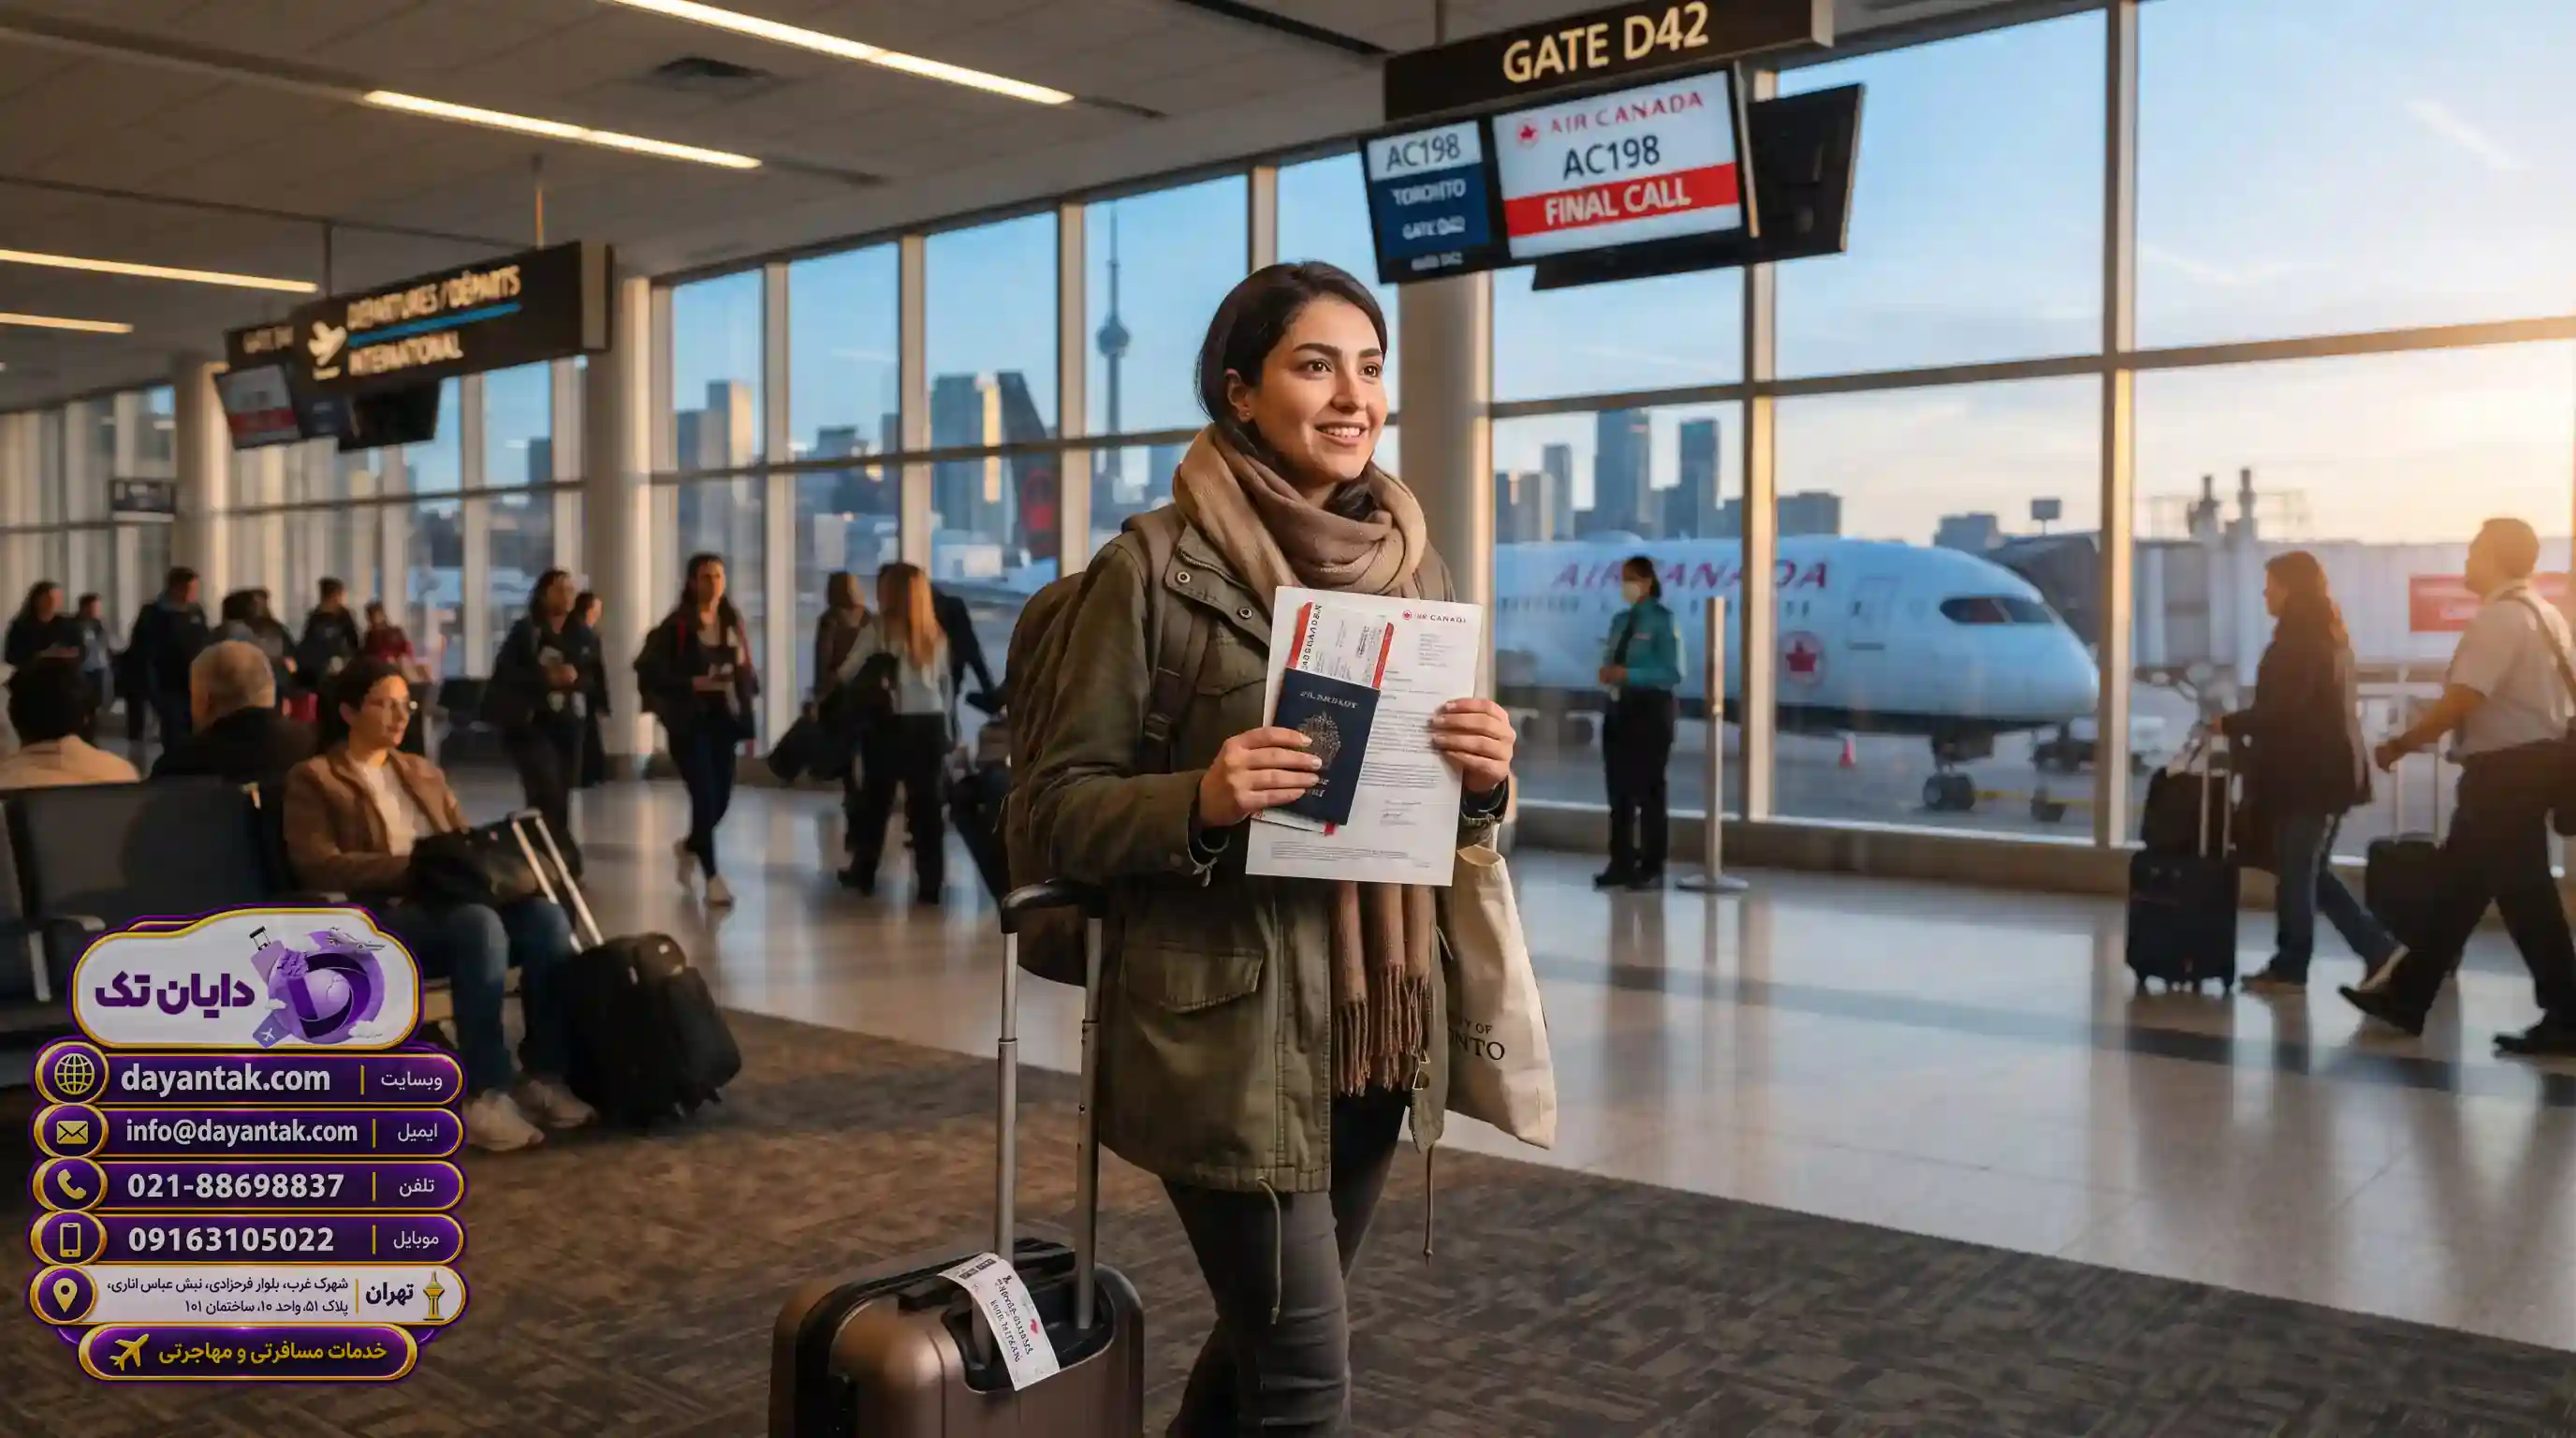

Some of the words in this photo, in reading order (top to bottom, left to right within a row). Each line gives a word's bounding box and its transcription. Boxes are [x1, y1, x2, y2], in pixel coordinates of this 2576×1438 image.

[1502, 22, 1609, 83] GATE
[1624, 1, 1709, 61] D42
[1550, 113, 1588, 135] AIR
[1595, 91, 1705, 126] CANADA
[1385, 133, 1460, 172] AC198
[1563, 134, 1661, 181] AC198
[1545, 189, 1619, 226] FINAL
[1623, 177, 1692, 213] CALL
